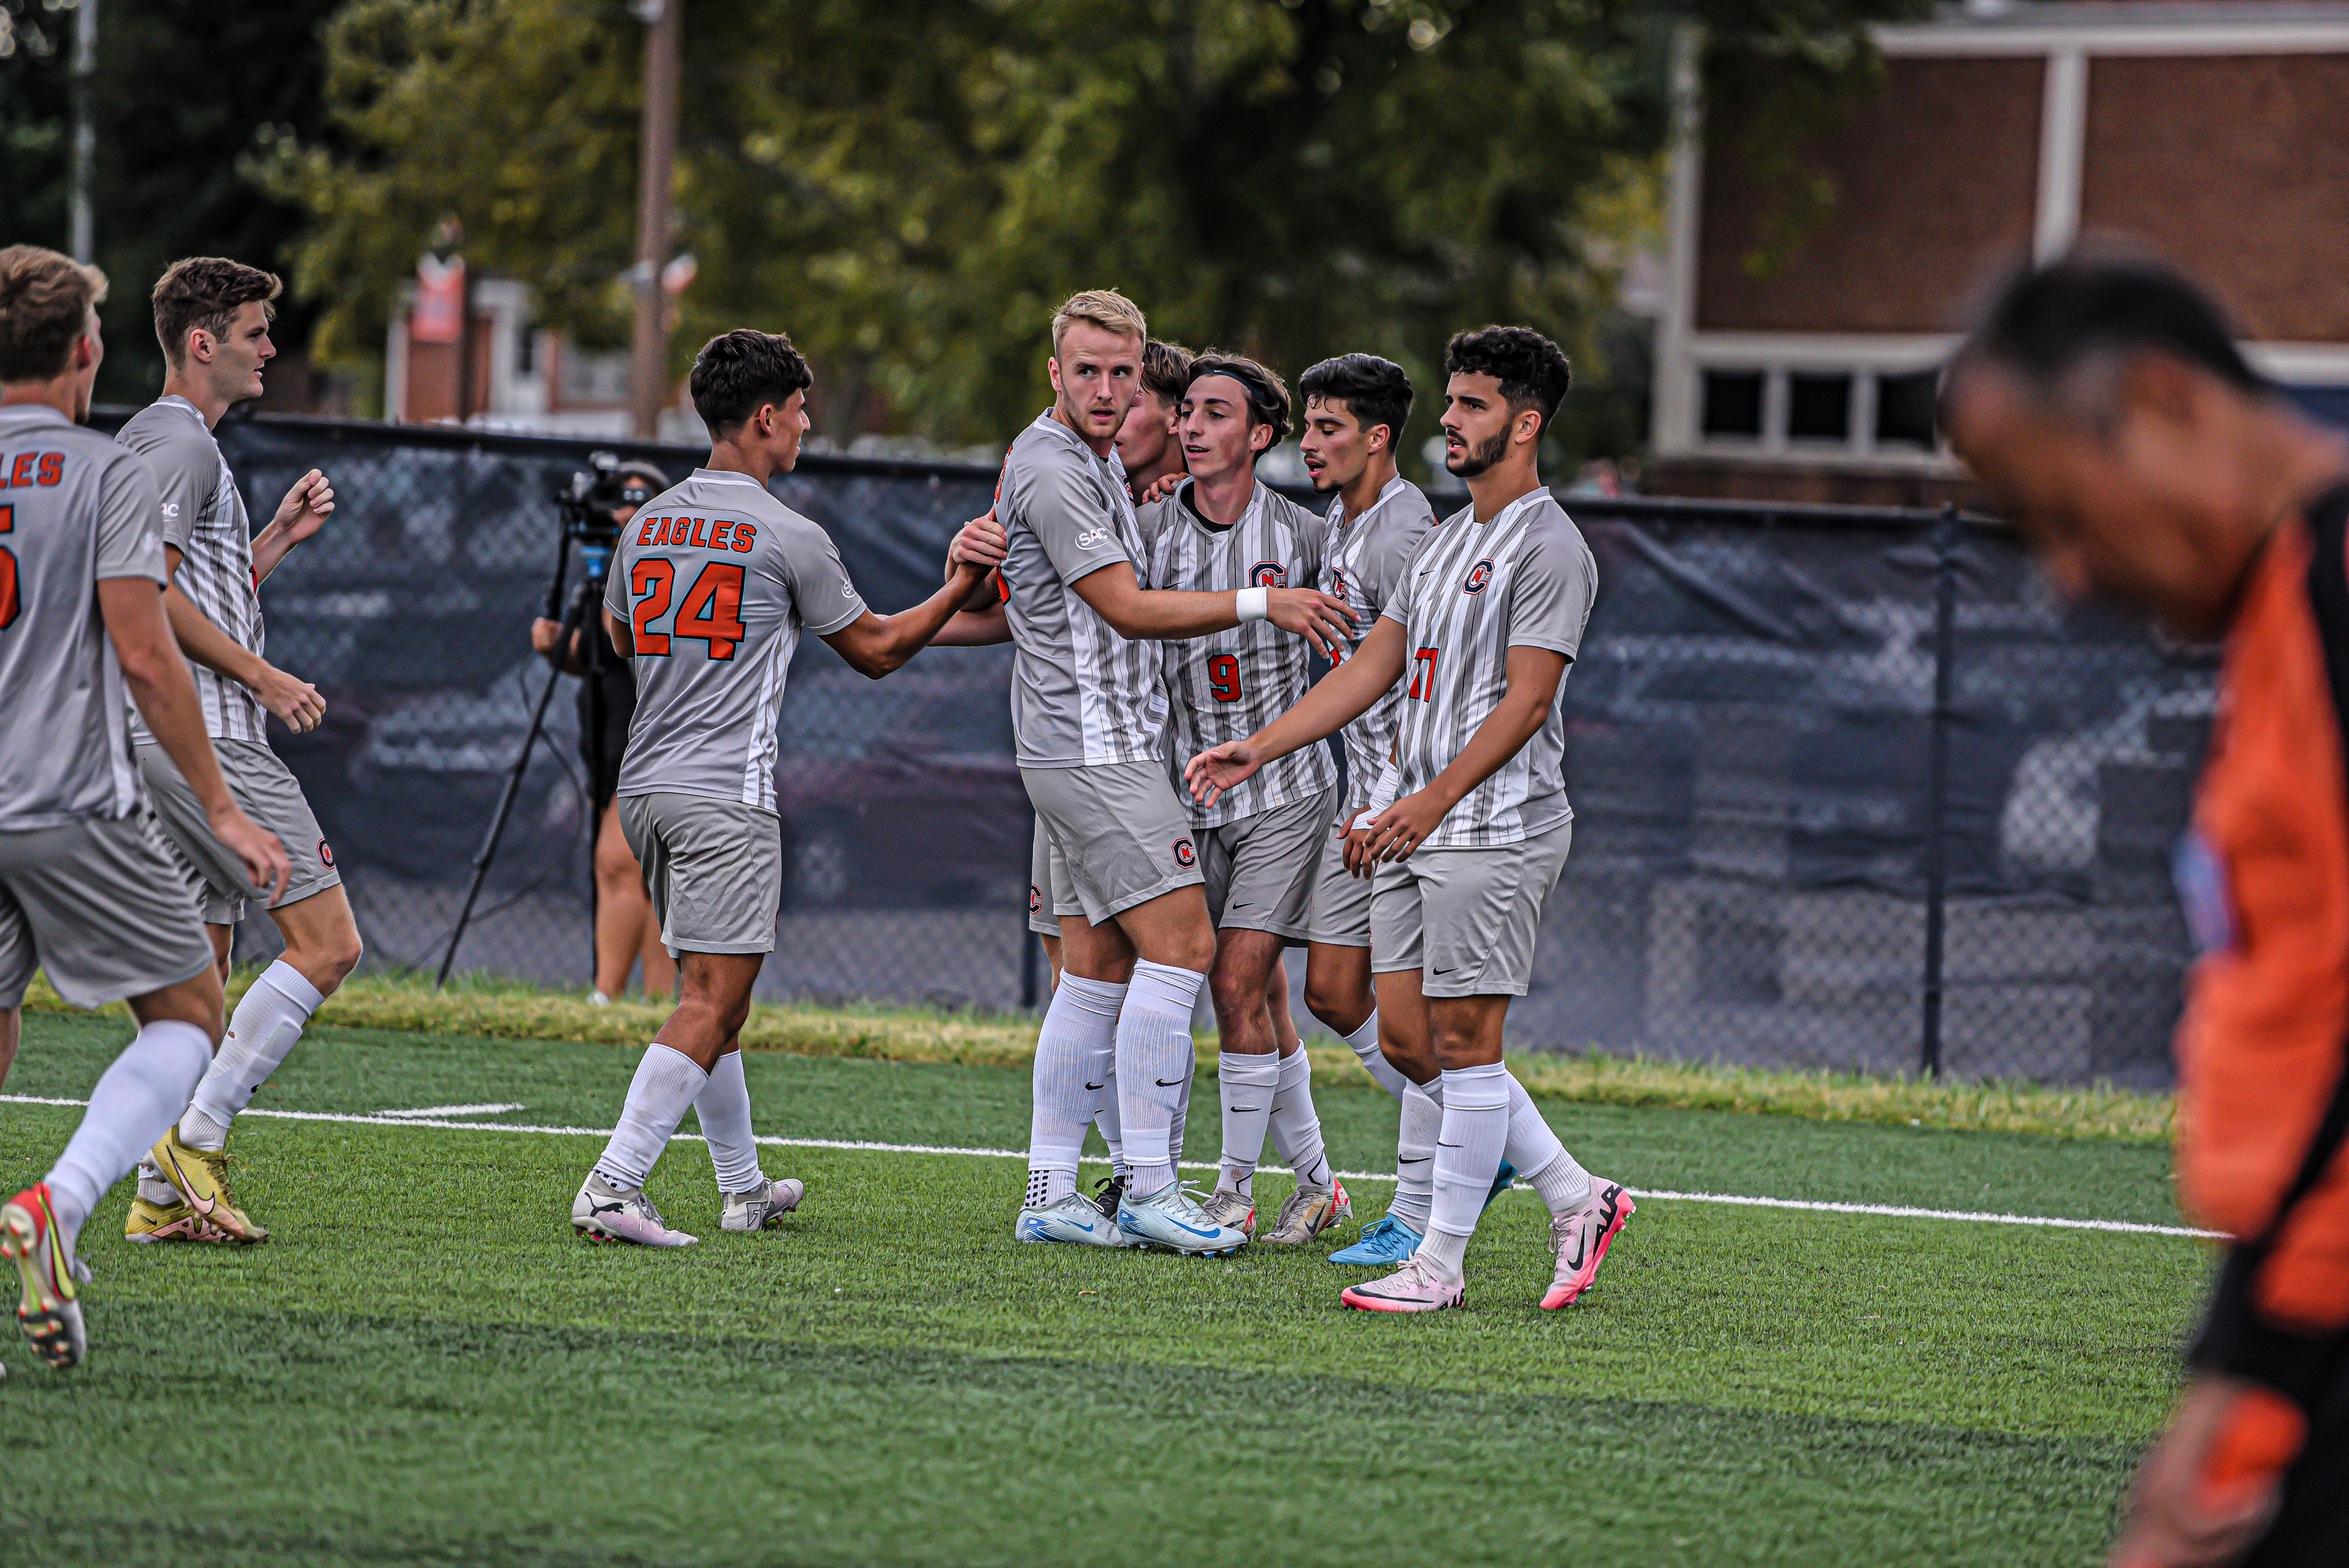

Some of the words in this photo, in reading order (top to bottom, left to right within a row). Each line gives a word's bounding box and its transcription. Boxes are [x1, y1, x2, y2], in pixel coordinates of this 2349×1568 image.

[636, 517, 757, 553] EAGLES
[1078, 527, 1108, 547] SAC
[631, 558, 746, 661] 24
[1207, 654, 1243, 703] 9
